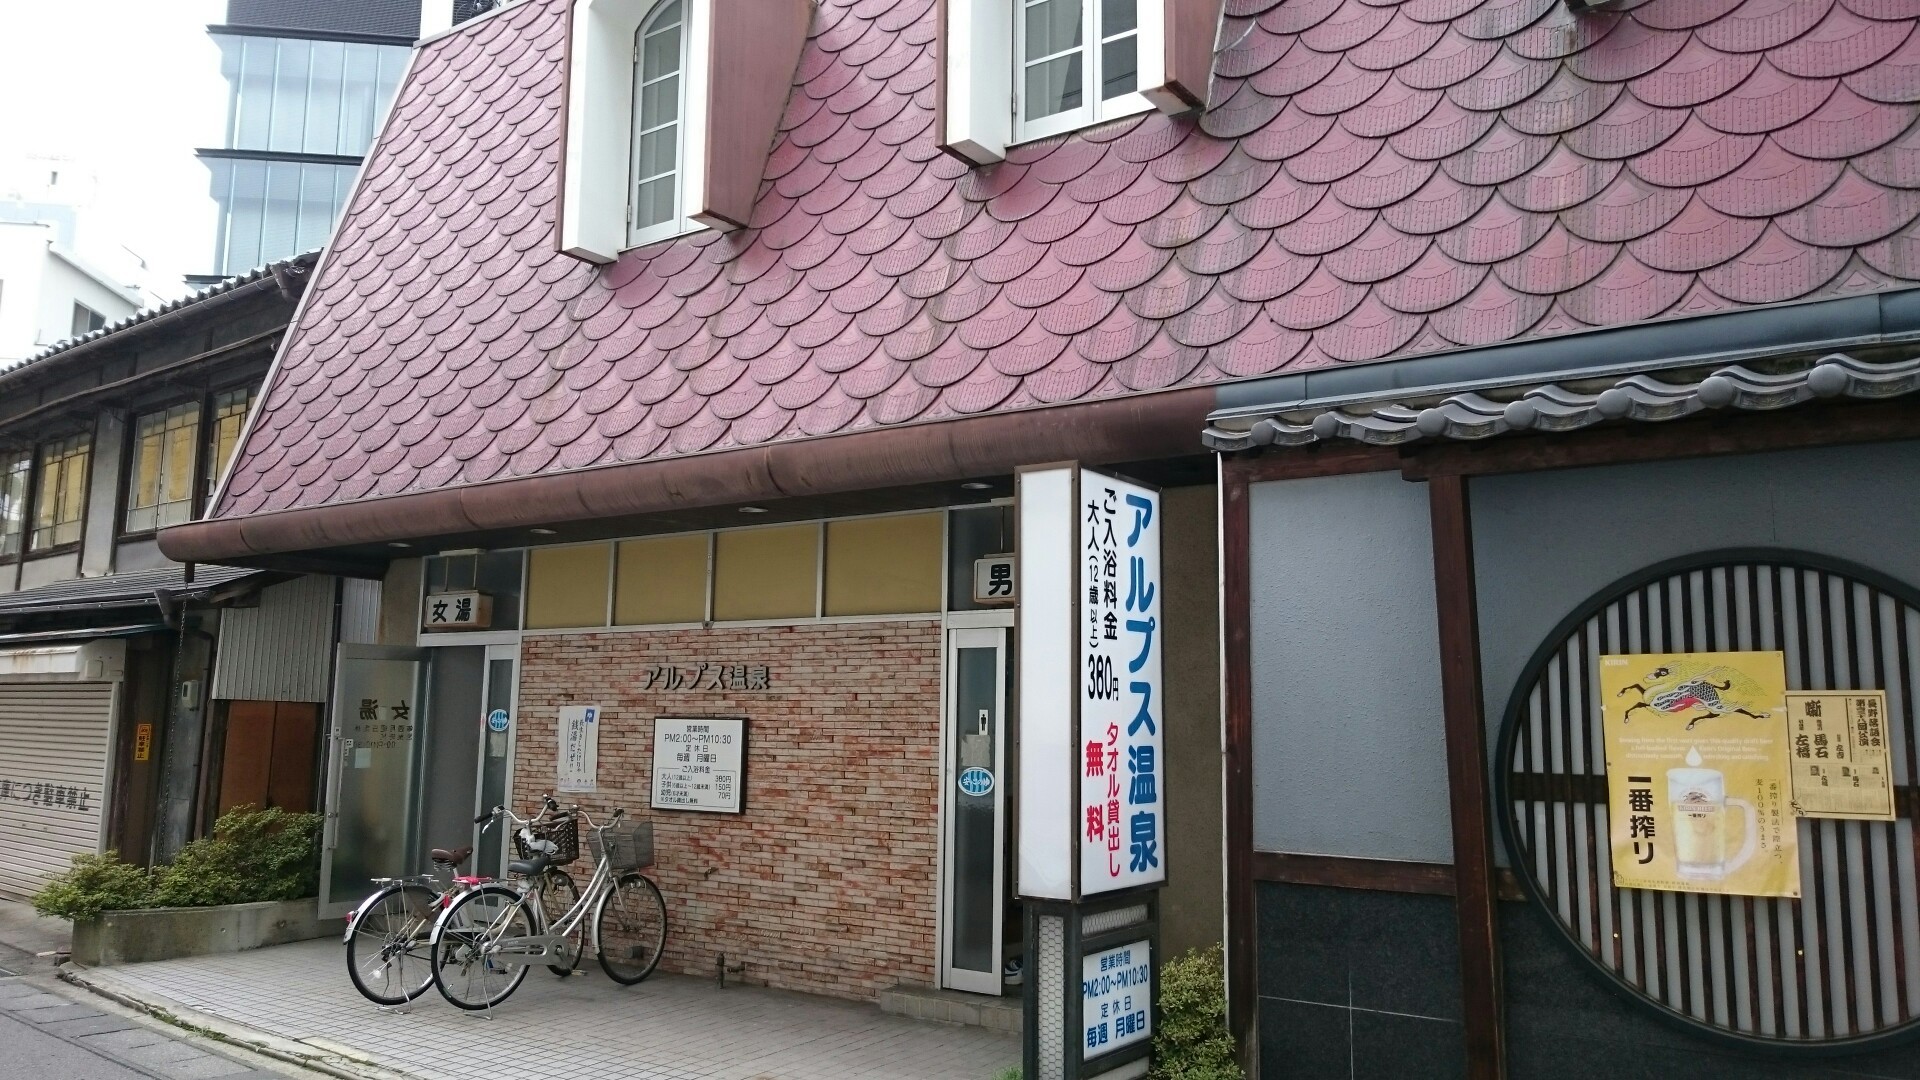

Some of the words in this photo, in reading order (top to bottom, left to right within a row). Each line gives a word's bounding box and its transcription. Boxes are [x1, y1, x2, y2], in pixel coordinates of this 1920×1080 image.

[988, 563, 1012, 596] 男
[1087, 499, 1100, 649] 大人(12歳以上)
[1102, 487, 1118, 641] ご入浴料金
[432, 597, 472, 624] 女湯
[644, 662, 772, 691] アルプス温泉
[1087, 653, 1119, 702] 380円
[1125, 493, 1159, 873] アルプス温泉
[682, 766, 711, 774] ご入浴料金
[1086, 740, 1104, 843] 無料
[1106, 722, 1121, 878] タオル貸出し
[1626, 775, 1656, 865] 一番搾り
[1100, 950, 1130, 972] 営業時間
[1086, 1022, 1108, 1048] 毎週
[1116, 1010, 1146, 1040] 月曜日
[1100, 996, 1132, 1020] 定休日
